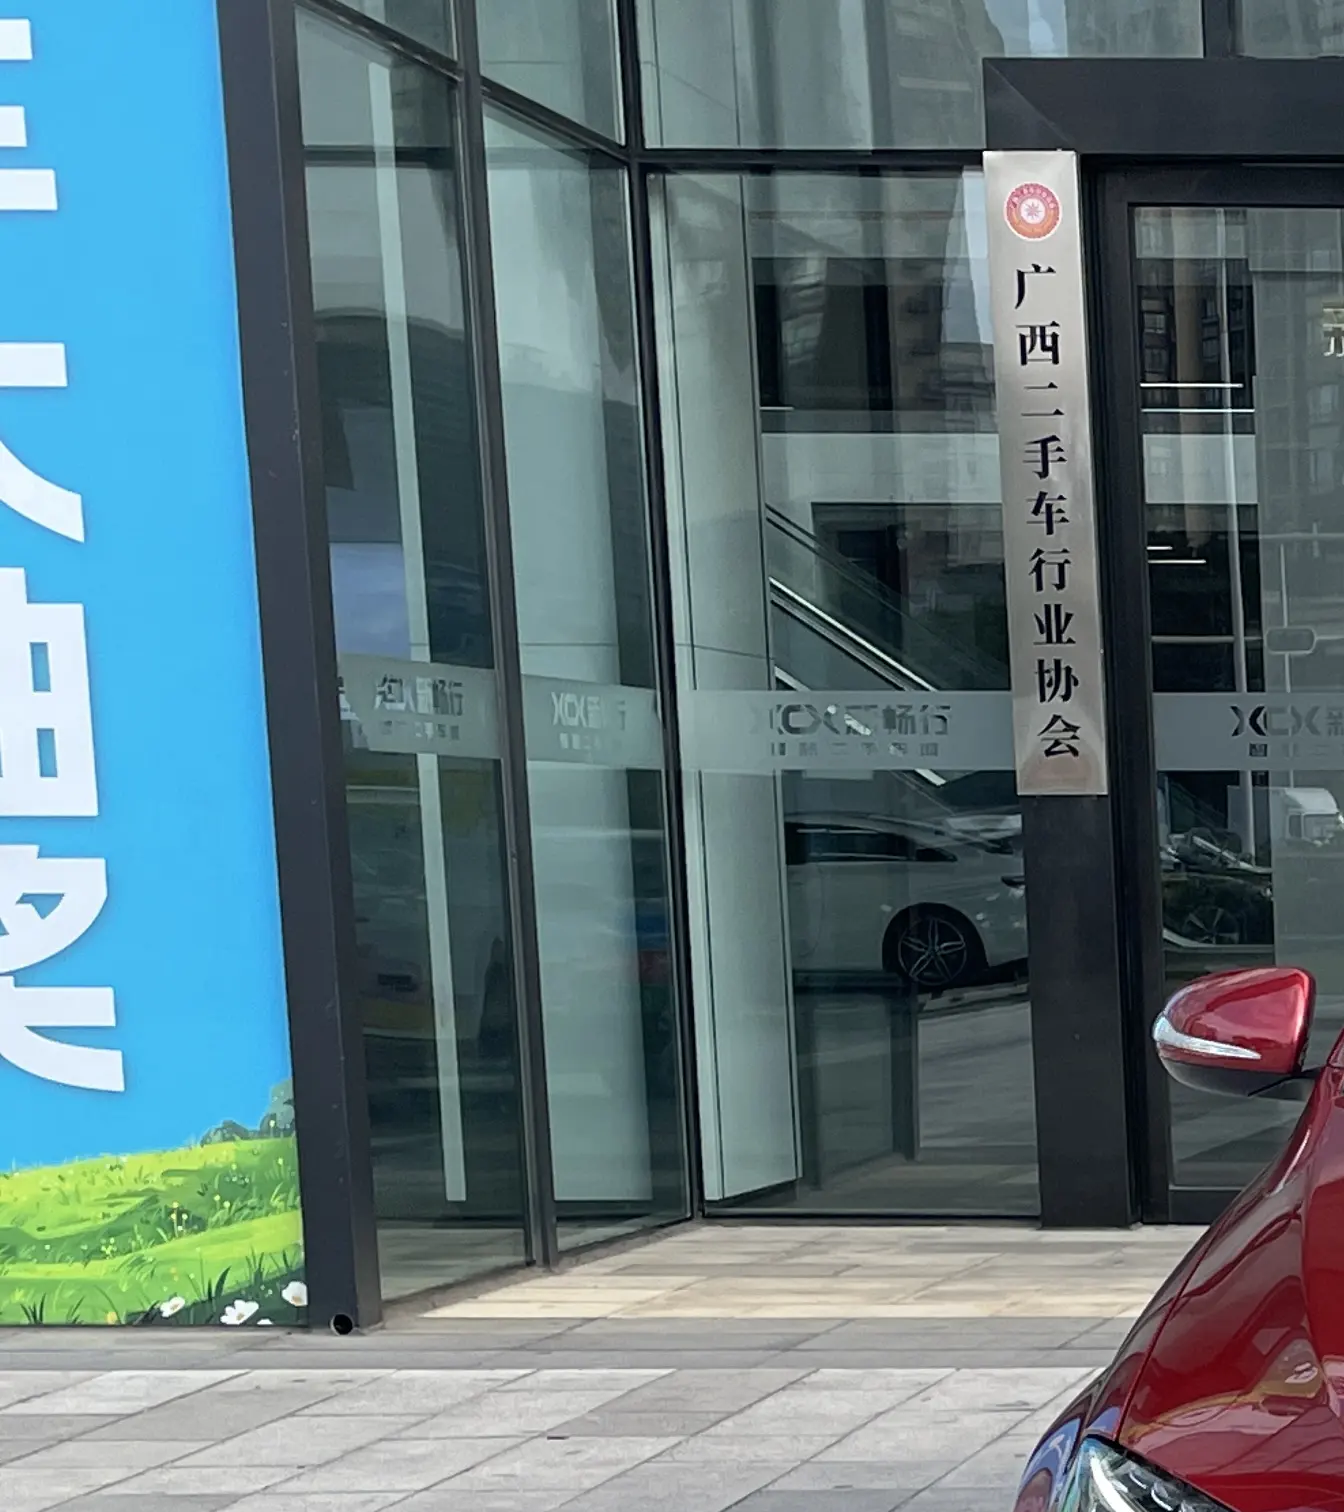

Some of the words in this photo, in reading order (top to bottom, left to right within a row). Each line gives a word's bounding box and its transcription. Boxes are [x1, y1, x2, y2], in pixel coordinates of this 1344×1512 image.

[1014, 263, 1082, 758] 广西二手车行业协会
